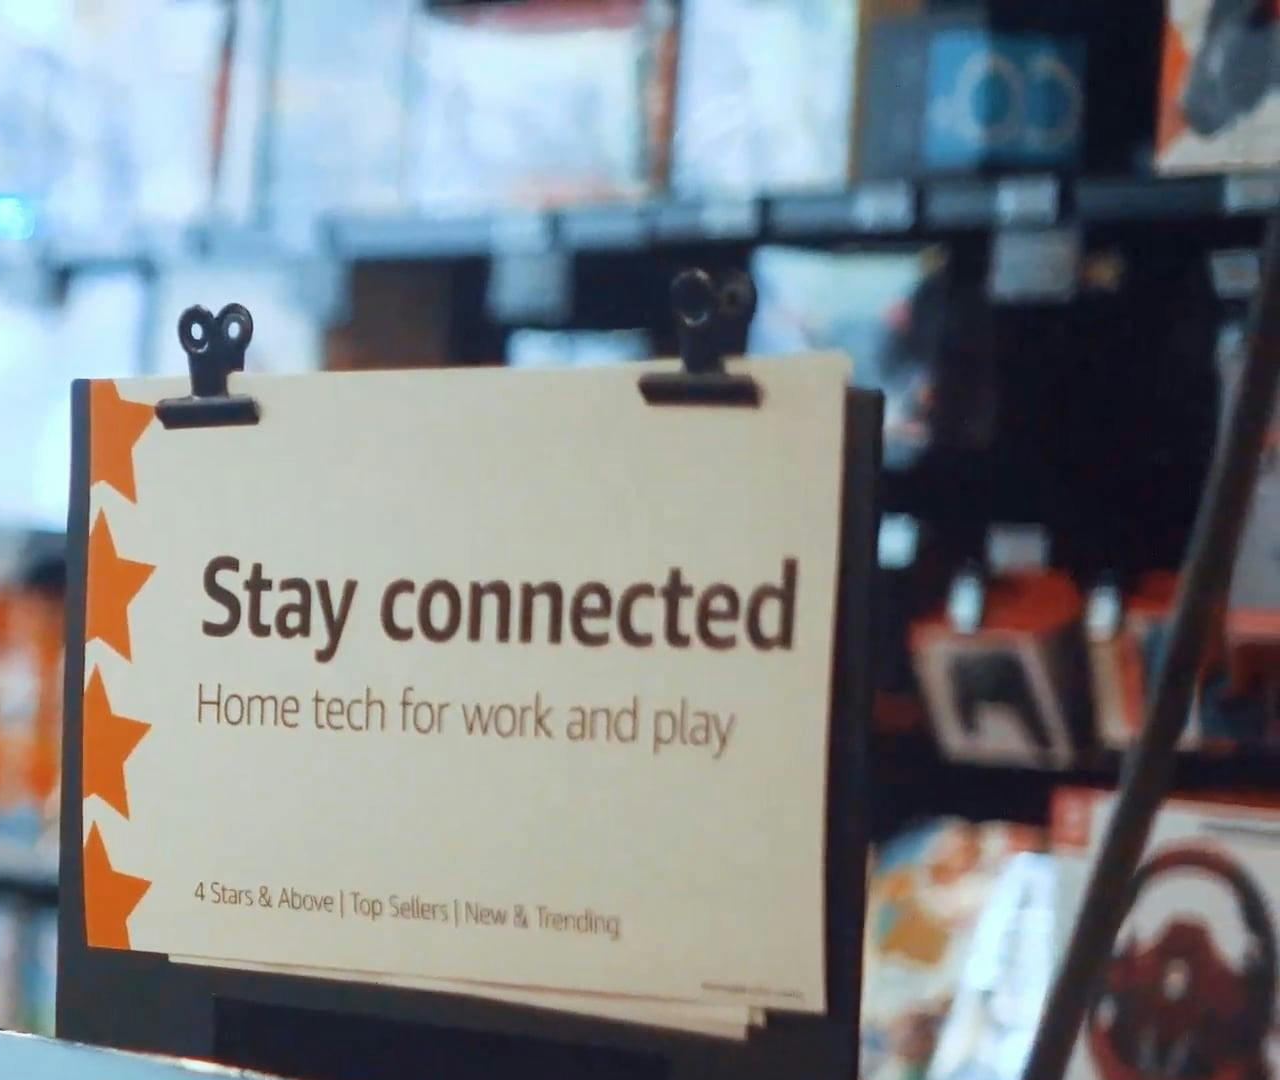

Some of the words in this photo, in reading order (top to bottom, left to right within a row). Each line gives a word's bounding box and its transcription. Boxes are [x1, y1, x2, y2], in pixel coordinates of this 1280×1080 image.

[201, 555, 358, 663] Stay
[380, 557, 799, 652] connected
[196, 683, 299, 729] Home
[313, 686, 385, 733] tech
[400, 687, 450, 735] for
[462, 691, 553, 740] work
[565, 695, 639, 744] and
[652, 698, 738, 760] play
[193, 881, 205, 902] 4
[210, 882, 254, 907] Stars
[259, 886, 273, 908] &
[278, 887, 333, 913] Above
[350, 891, 383, 918] Top
[389, 894, 448, 923] Sellers
[464, 901, 507, 926] New
[512, 904, 529, 930] &
[537, 904, 621, 941] Trending
